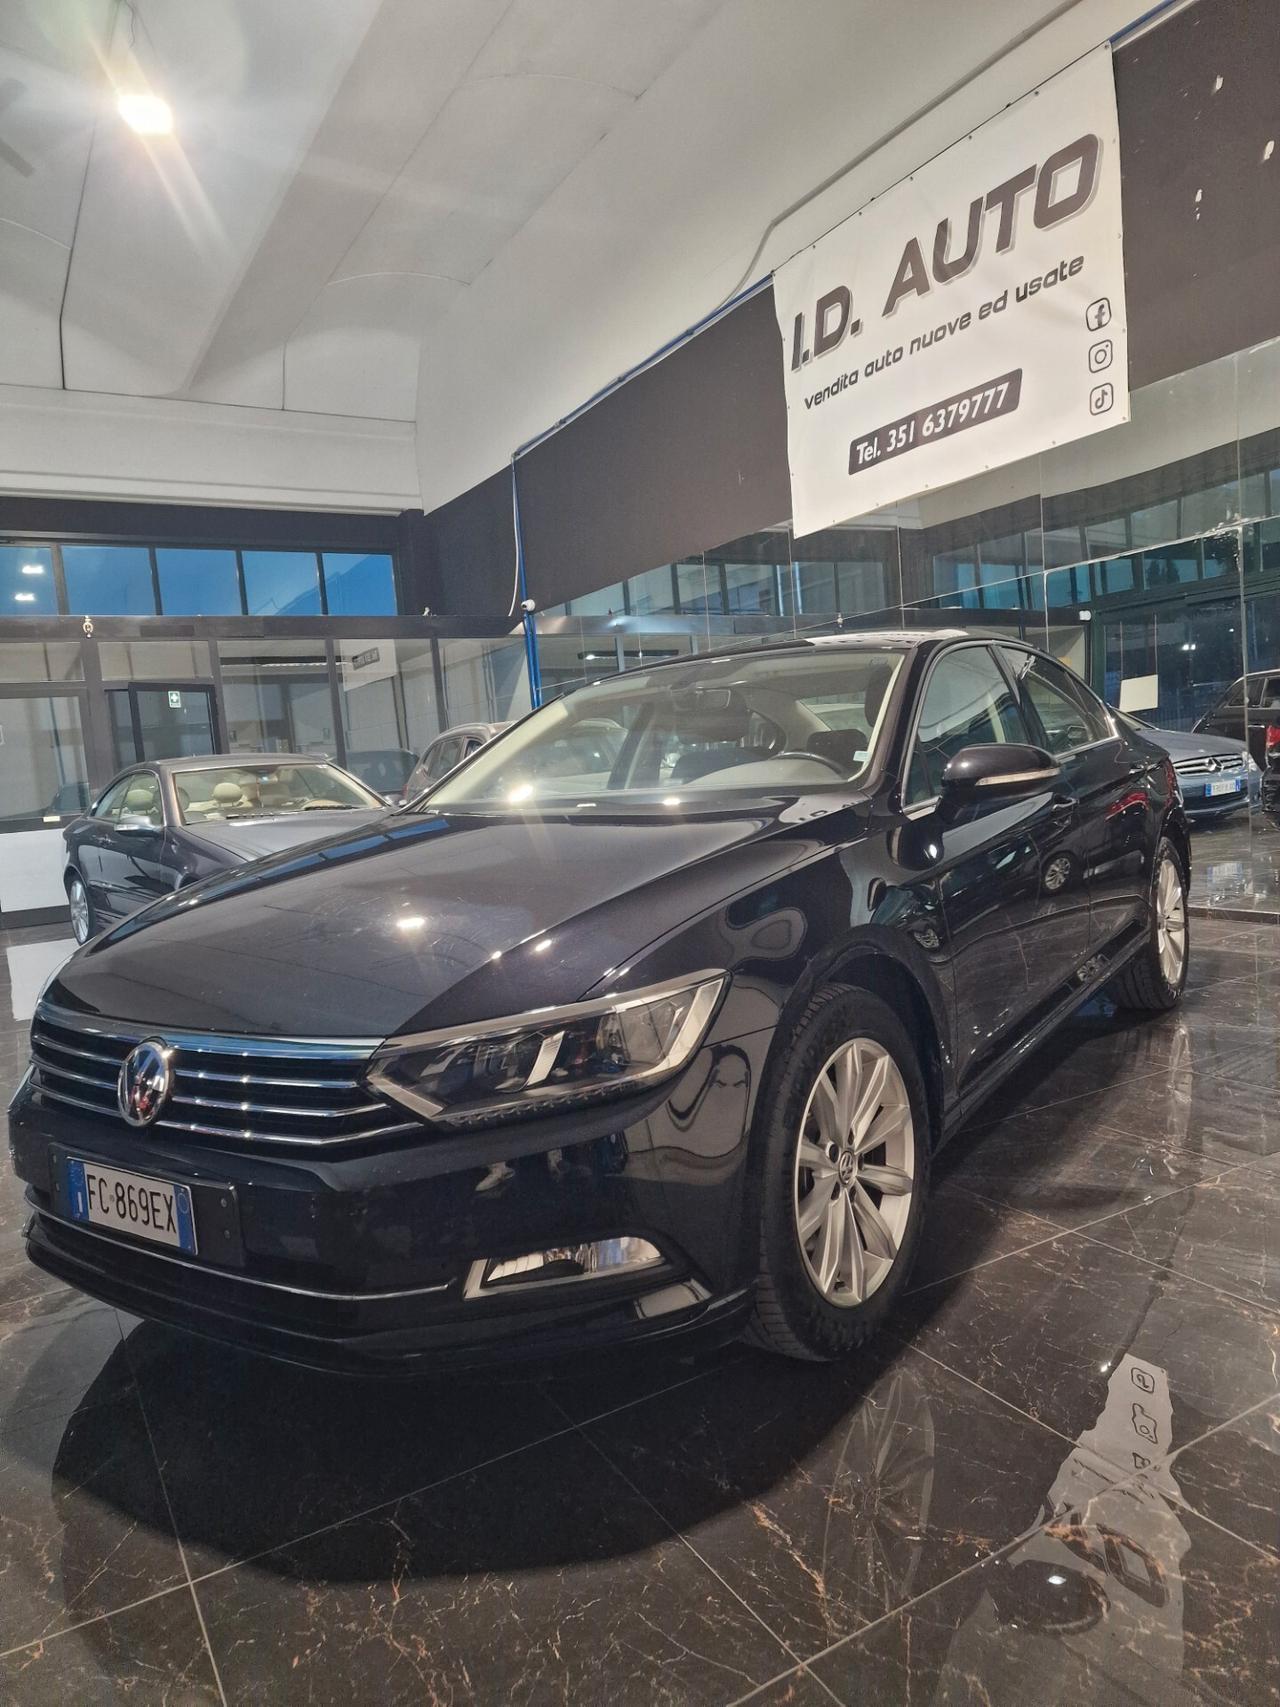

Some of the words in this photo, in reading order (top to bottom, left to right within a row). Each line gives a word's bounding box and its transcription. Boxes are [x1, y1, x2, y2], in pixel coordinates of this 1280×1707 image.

[791, 285, 862, 372] I.D.
[881, 133, 1101, 318] AUTO
[804, 369, 859, 410] vendita
[864, 345, 904, 378] auto
[909, 311, 972, 355] nuove
[978, 289, 1009, 321] ed
[1015, 255, 1085, 303] usate
[856, 436, 882, 465] Tel.
[886, 419, 916, 452] 351
[921, 381, 1010, 438] 6379777
